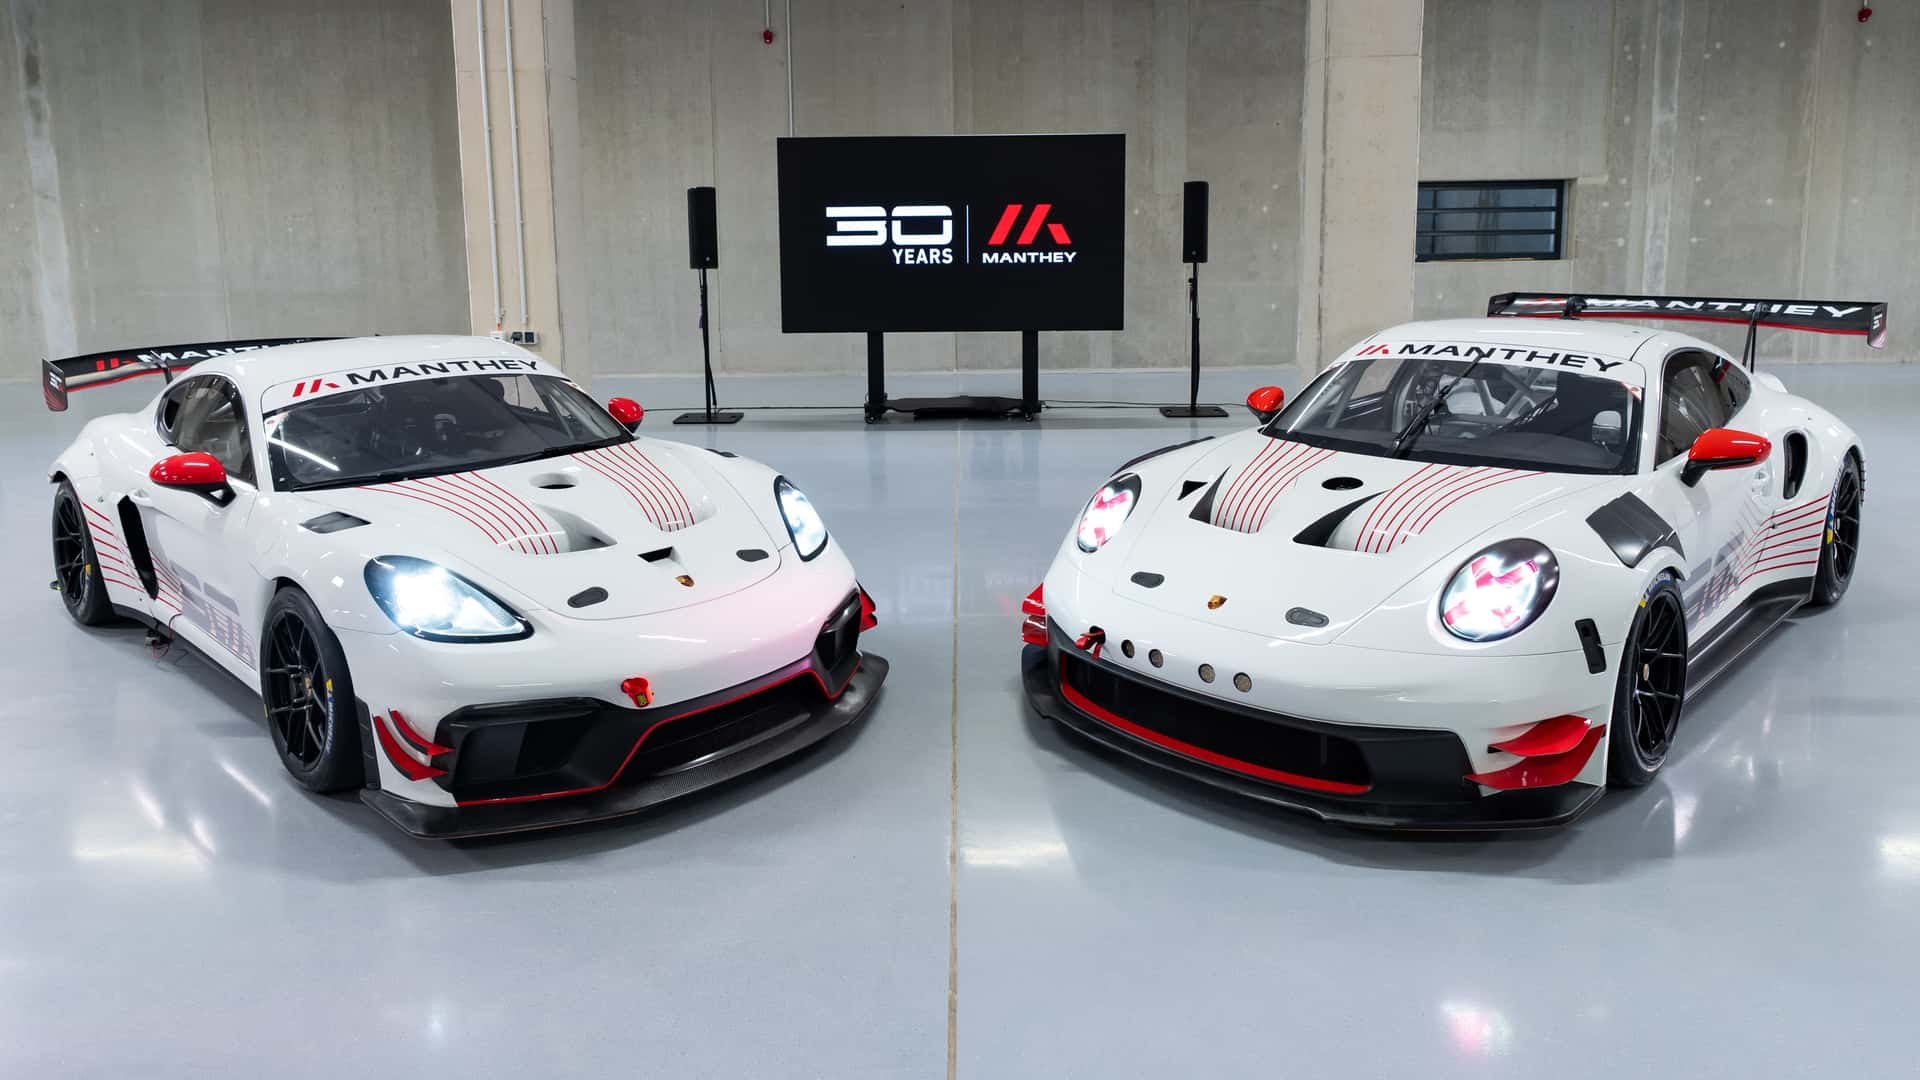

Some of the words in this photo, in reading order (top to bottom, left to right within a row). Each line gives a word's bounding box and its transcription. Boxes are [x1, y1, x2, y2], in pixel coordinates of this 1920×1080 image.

[826, 205, 953, 247] 30
[892, 248, 954, 265] YEARS
[982, 251, 1077, 264] MANTHEY
[1398, 343, 1624, 372] MANTHEY
[346, 359, 538, 385] MANTHEY
